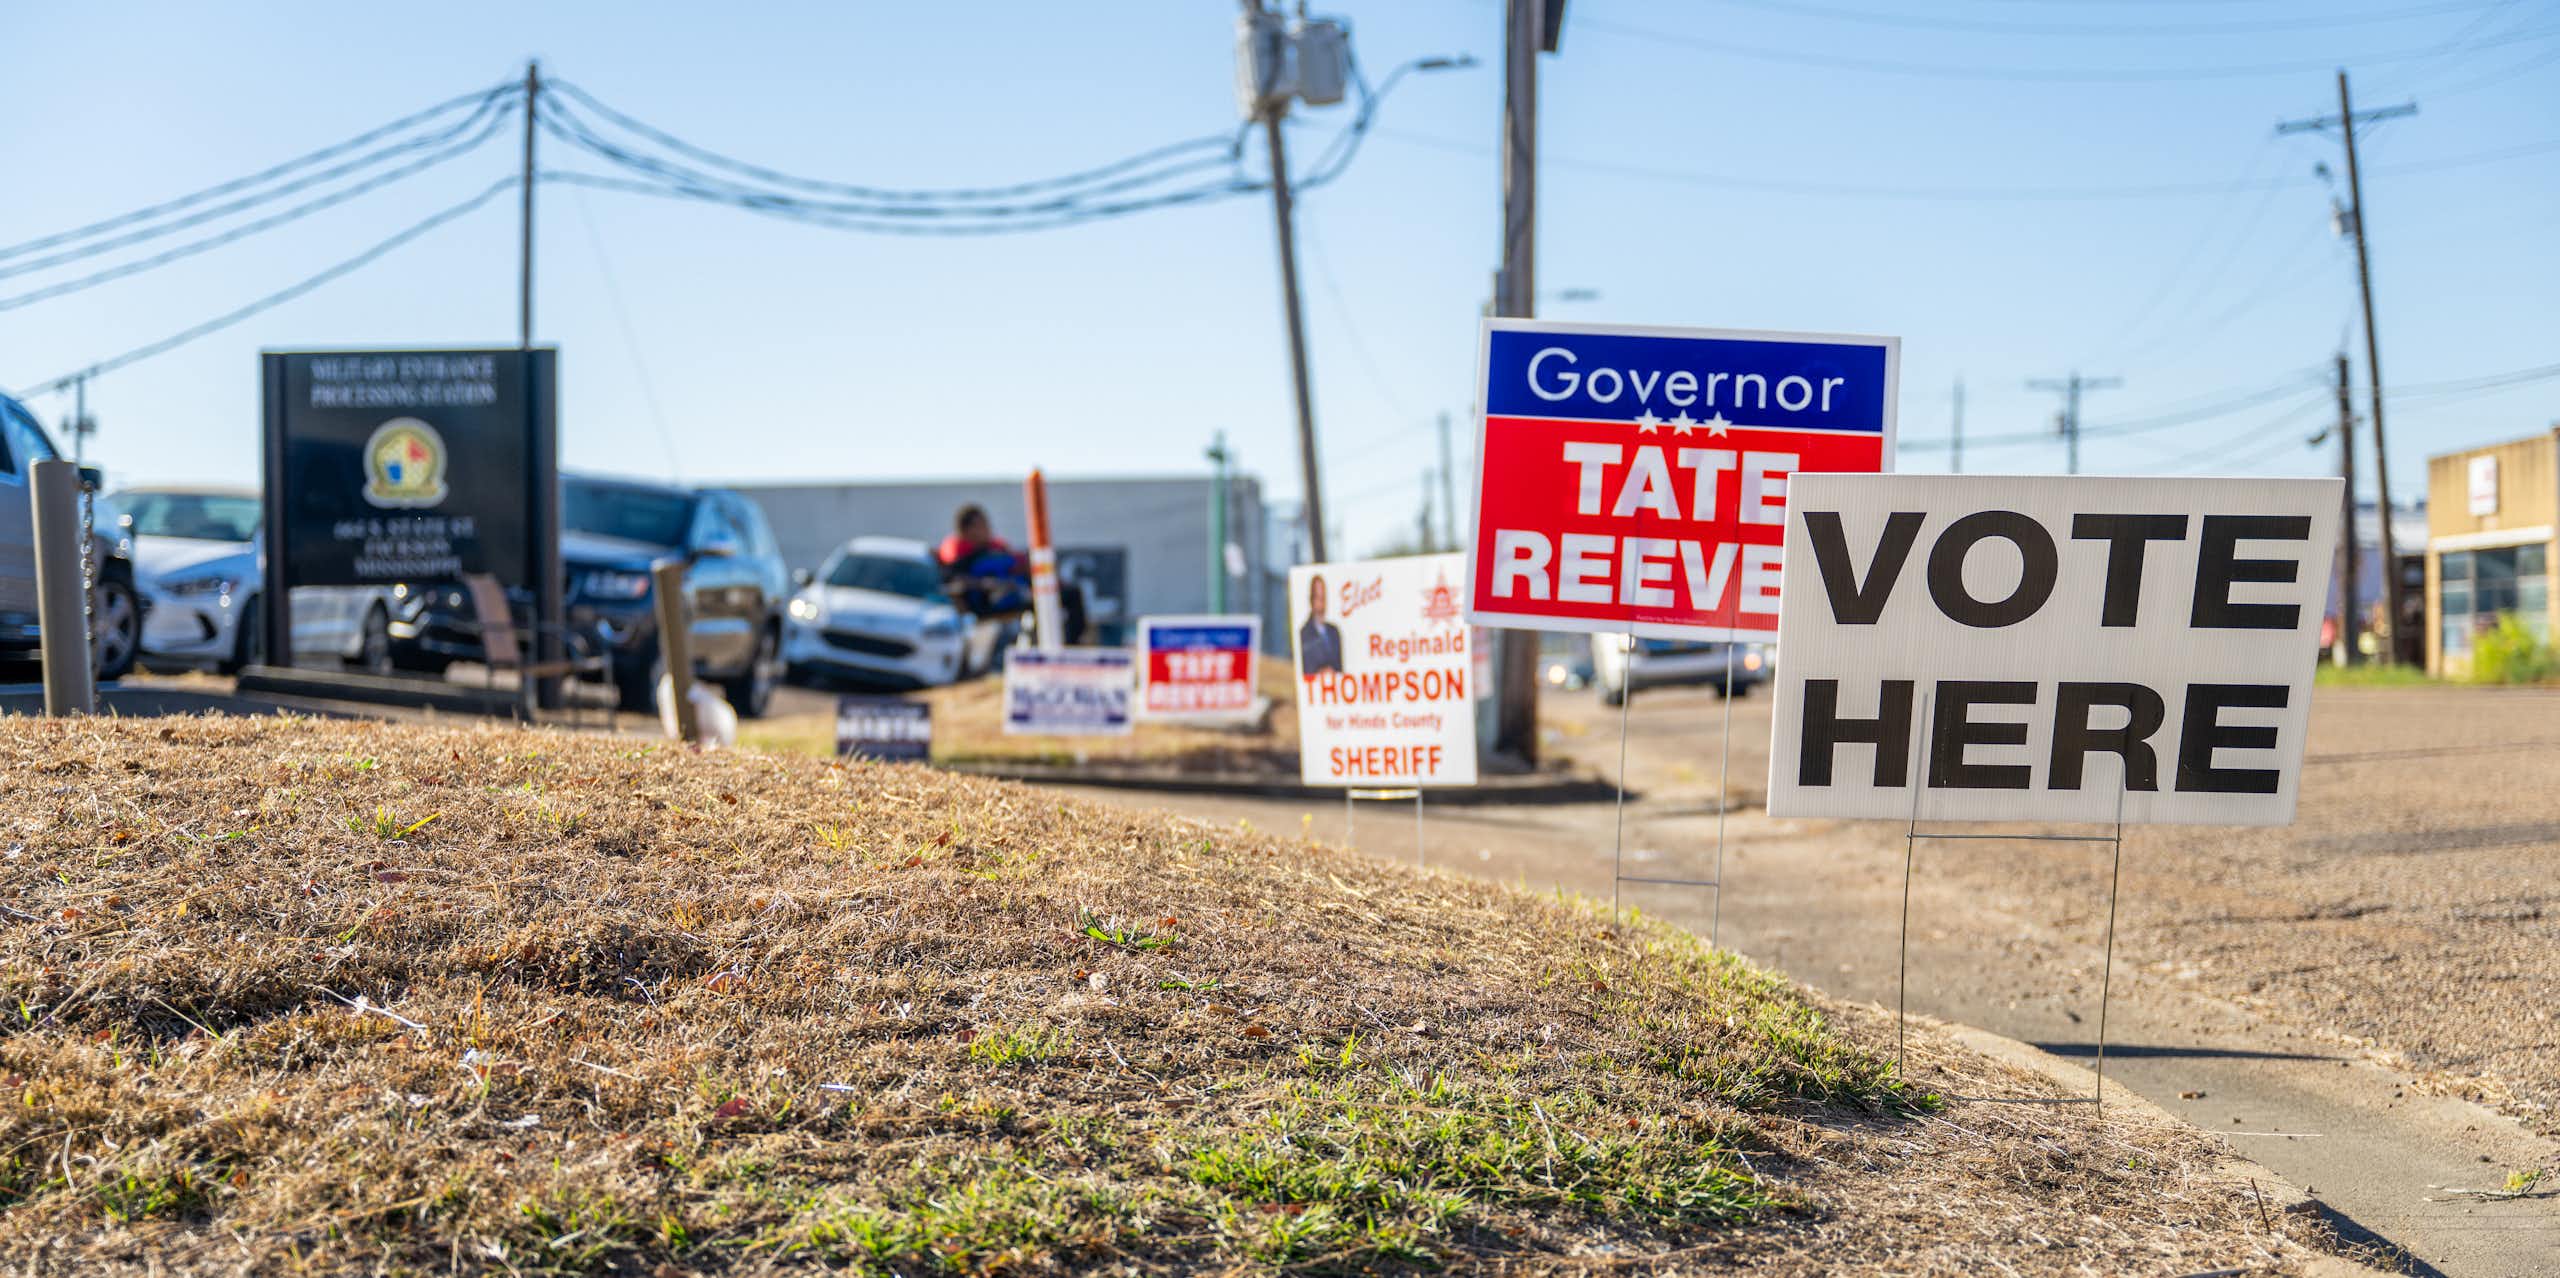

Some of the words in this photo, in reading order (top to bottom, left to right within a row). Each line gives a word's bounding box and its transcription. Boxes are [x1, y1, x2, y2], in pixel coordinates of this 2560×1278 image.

[1527, 347, 1844, 412] Governor
[1563, 441, 1800, 525] TATE
[1491, 529, 1784, 615] REEVE
[1802, 510, 2312, 629] VOTE
[1340, 576, 1382, 619] Elect
[1369, 630, 1465, 663] Reginald
[1303, 668, 1465, 705] THOMPSON
[1349, 714, 1387, 730] Hinds
[1392, 713, 1443, 732] County
[1798, 679, 2290, 794] HERE
[1329, 746, 1443, 778] SHERIFF
